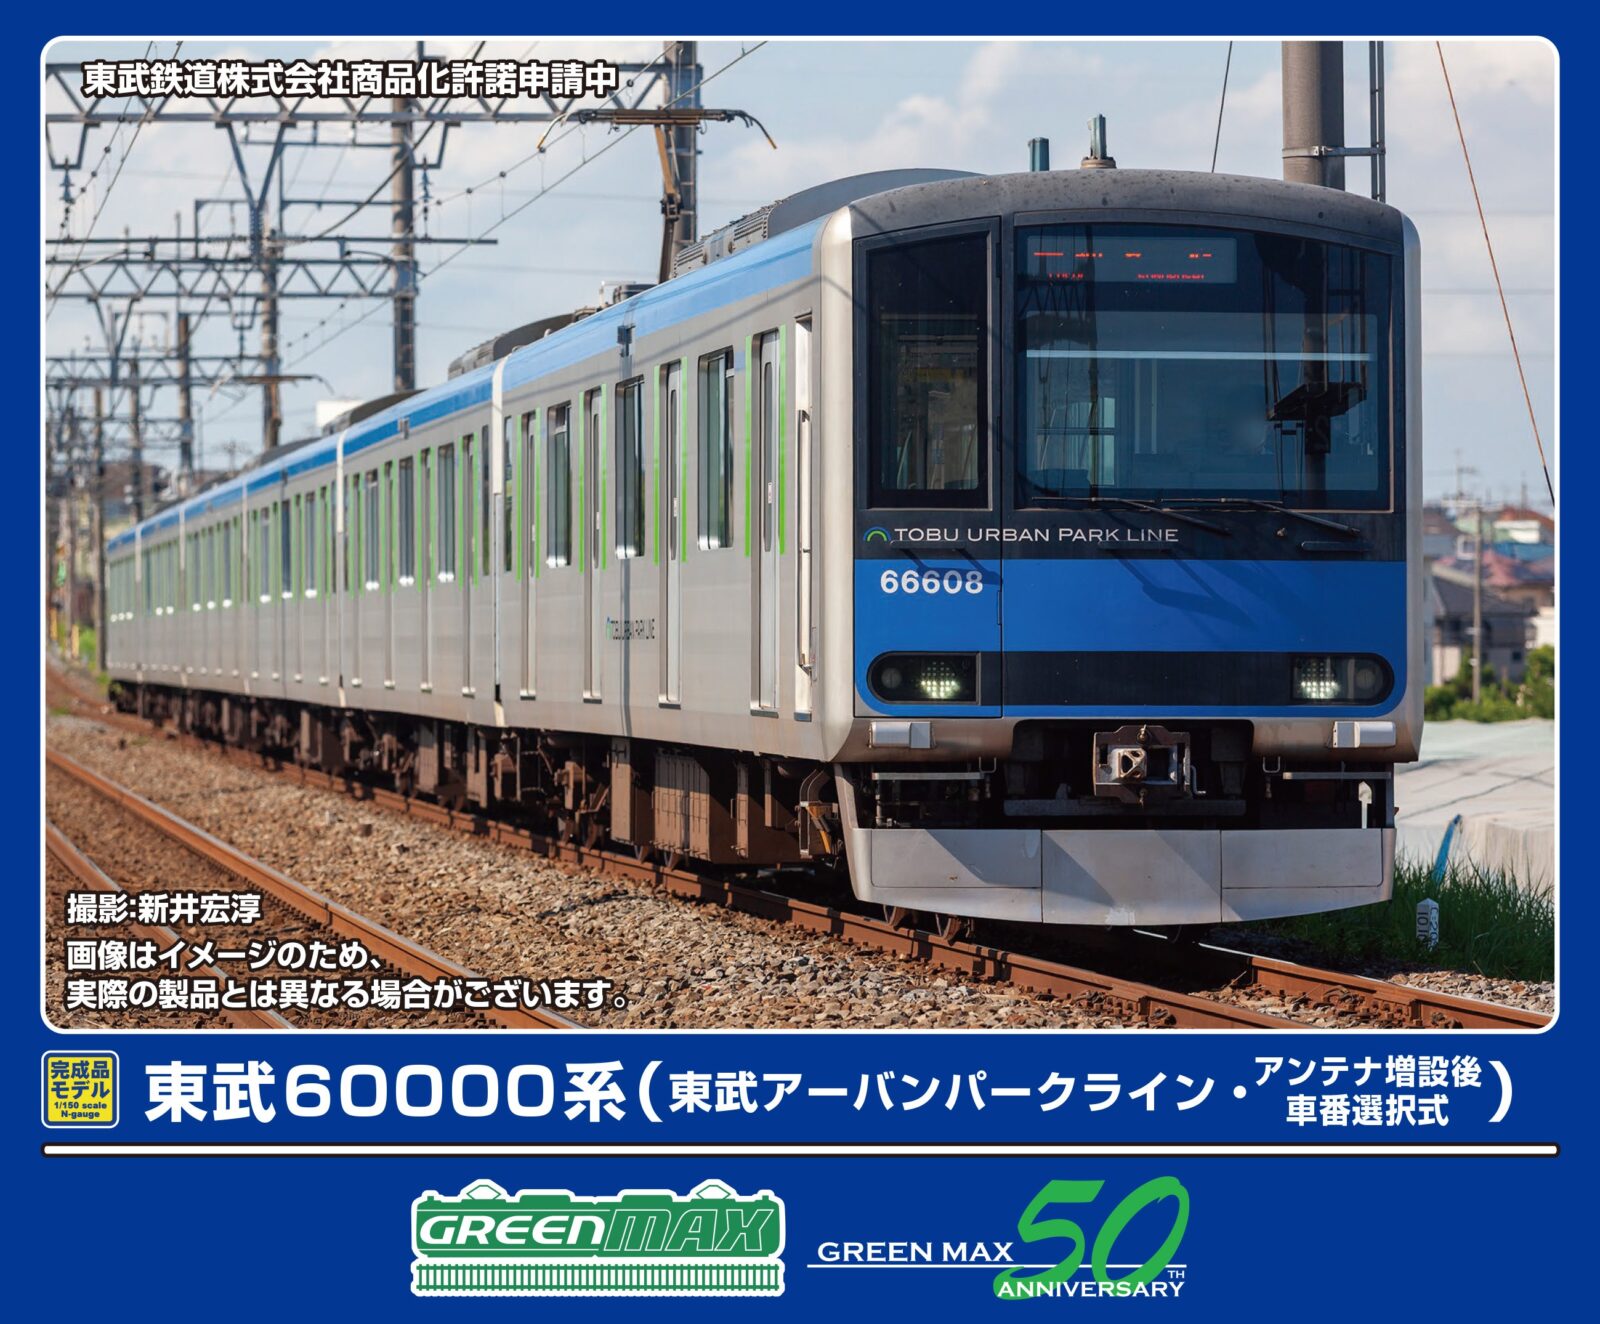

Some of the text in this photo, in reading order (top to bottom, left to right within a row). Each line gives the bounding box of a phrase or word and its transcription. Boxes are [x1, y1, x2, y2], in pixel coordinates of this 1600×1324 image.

[894, 527, 1179, 542] TOBU URBAN PARK LINE
[880, 570, 984, 594] 66608
[51, 1060, 109, 1079] 完成品
[1255, 1054, 1482, 1088] アンテナ増設後
[51, 1081, 110, 1099] モデル
[61, 1110, 100, 1119] N-gauge
[1286, 1093, 1449, 1127] 車番選択式
[817, 1241, 932, 1262] GREEN
[942, 1241, 1014, 1262] MAX
[1167, 1270, 1185, 1279] TH
[997, 1281, 1185, 1297] ANNIVERSARY
